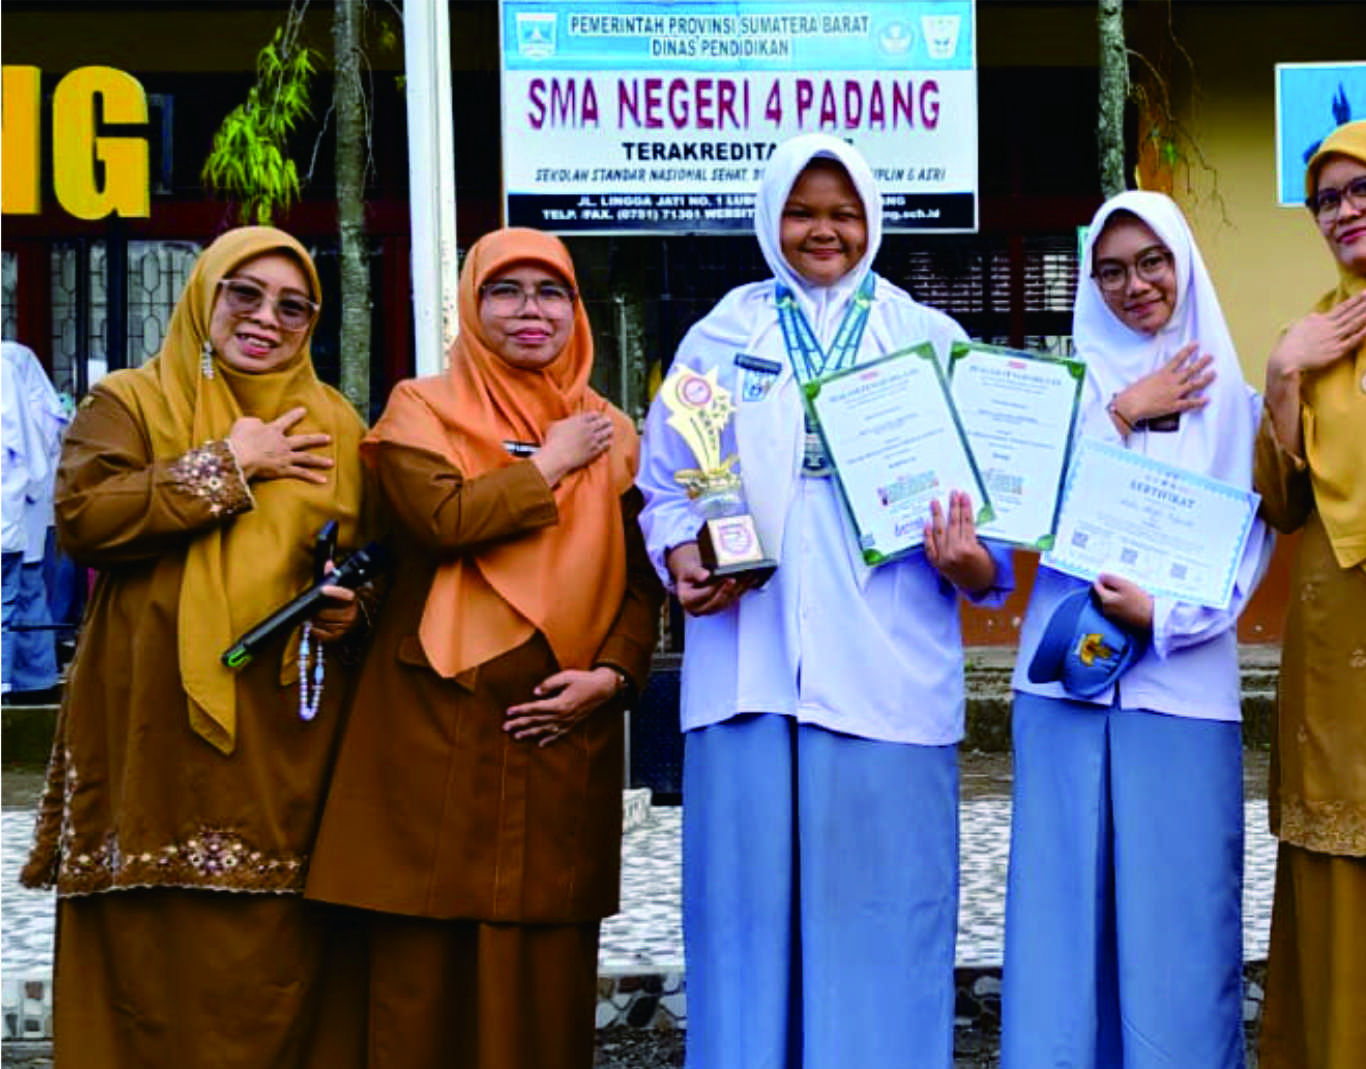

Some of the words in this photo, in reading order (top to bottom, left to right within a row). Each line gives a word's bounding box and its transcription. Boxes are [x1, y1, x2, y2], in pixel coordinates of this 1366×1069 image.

[571, 15, 664, 33] PEMERINTAH
[669, 17, 736, 34] PROVINSI
[741, 16, 817, 34] SUMATERA
[823, 16, 869, 33] BARAT
[652, 39, 696, 56] DINAS
[701, 39, 789, 56] PENDIDIKAN
[528, 78, 598, 130] SMA
[618, 78, 750, 130] NEGERI
[764, 78, 782, 130] 4
[796, 79, 940, 131] PADANG
